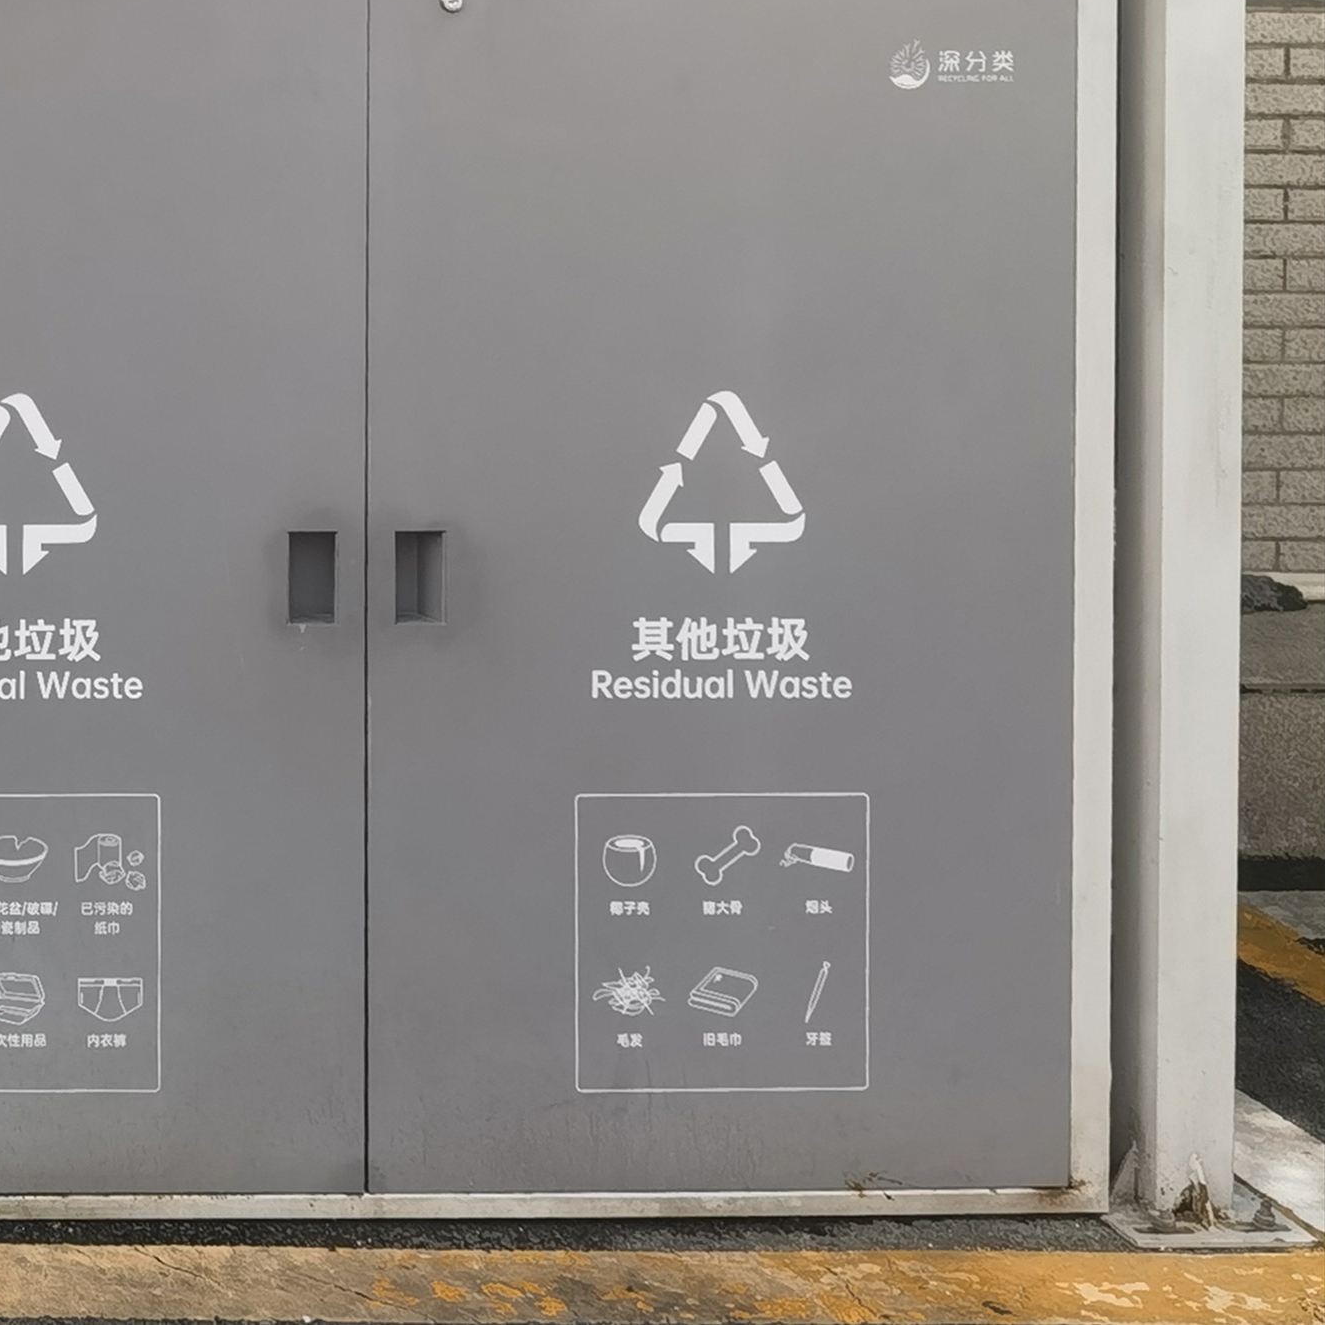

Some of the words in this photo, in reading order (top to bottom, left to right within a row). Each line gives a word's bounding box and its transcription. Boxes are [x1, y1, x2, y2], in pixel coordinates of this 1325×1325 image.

[938, 50, 1013, 72] 深分类
[632, 617, 810, 661] 其他垃圾
[36, 671, 143, 699] Waste
[592, 669, 733, 699] Residual
[744, 670, 852, 699] Waste
[81, 902, 133, 915] 已污染的
[610, 901, 649, 915] 椰子壳
[806, 900, 832, 914] 烟头
[95, 921, 119, 935] 纸巾
[88, 1034, 126, 1047] 内衣裤
[617, 1033, 643, 1047] 毛发
[703, 1033, 742, 1046] 旧毛巾
[806, 1032, 831, 1045] 牙签
